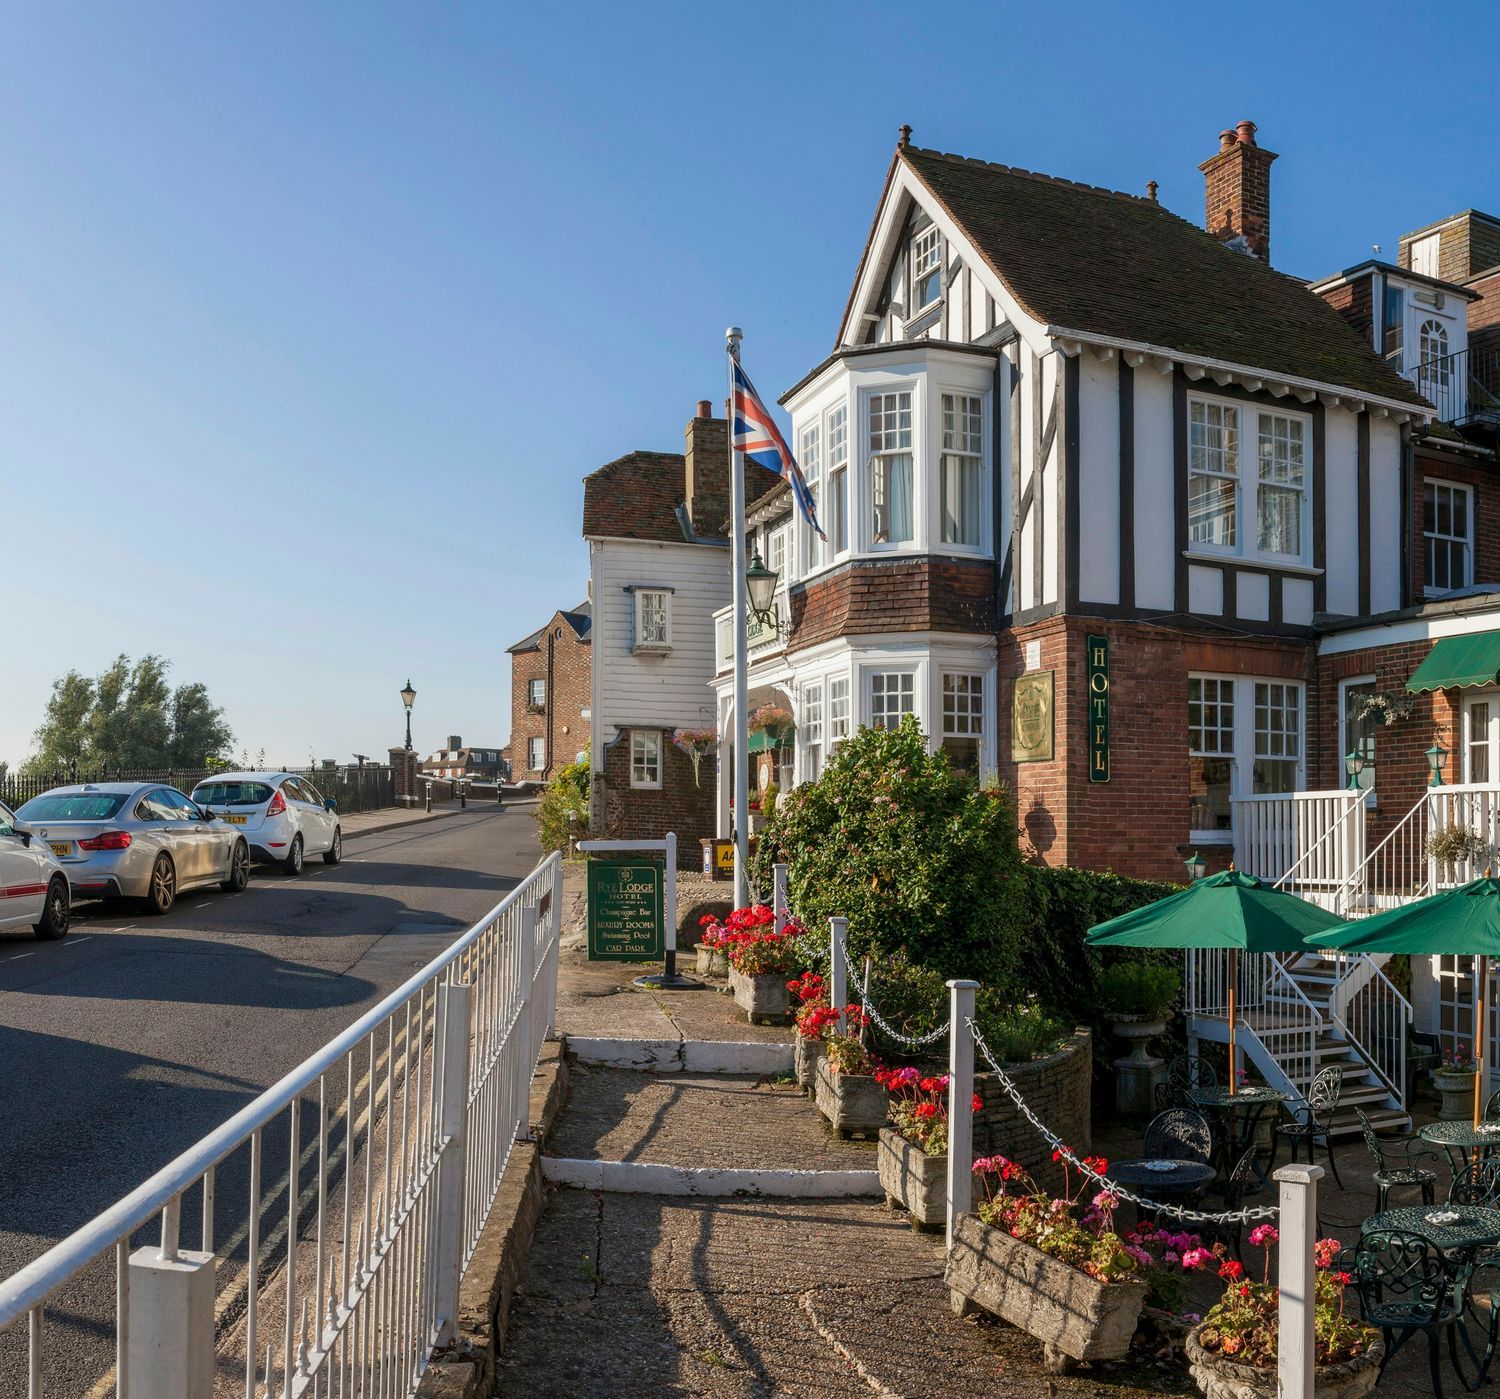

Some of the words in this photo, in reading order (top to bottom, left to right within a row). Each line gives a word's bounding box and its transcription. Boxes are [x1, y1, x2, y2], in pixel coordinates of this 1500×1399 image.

[1092, 647, 1108, 771] HOTEL
[722, 851, 734, 861] AA
[619, 882, 654, 893] LODGE
[633, 931, 650, 939] Pool
